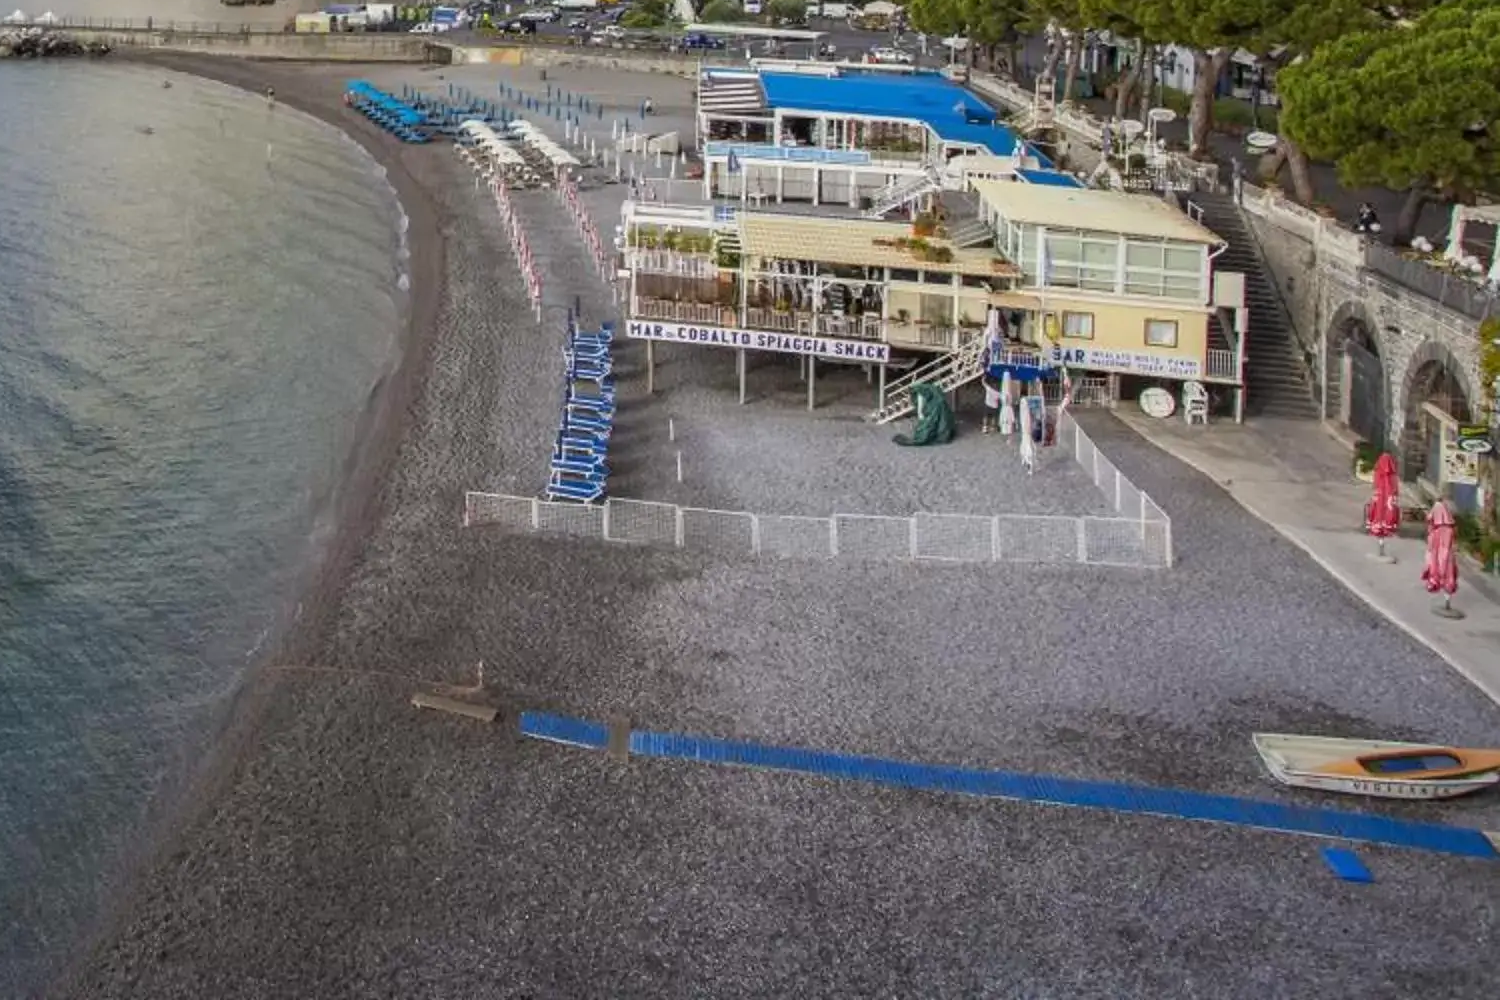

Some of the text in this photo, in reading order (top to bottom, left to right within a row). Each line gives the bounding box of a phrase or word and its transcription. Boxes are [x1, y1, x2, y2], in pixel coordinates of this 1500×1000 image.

[631, 323, 663, 337] MAR
[677, 327, 750, 344] COBALTO
[757, 334, 827, 353] SPIAGGIA
[835, 342, 885, 359] SNACK
[1052, 347, 1085, 363] BAR
